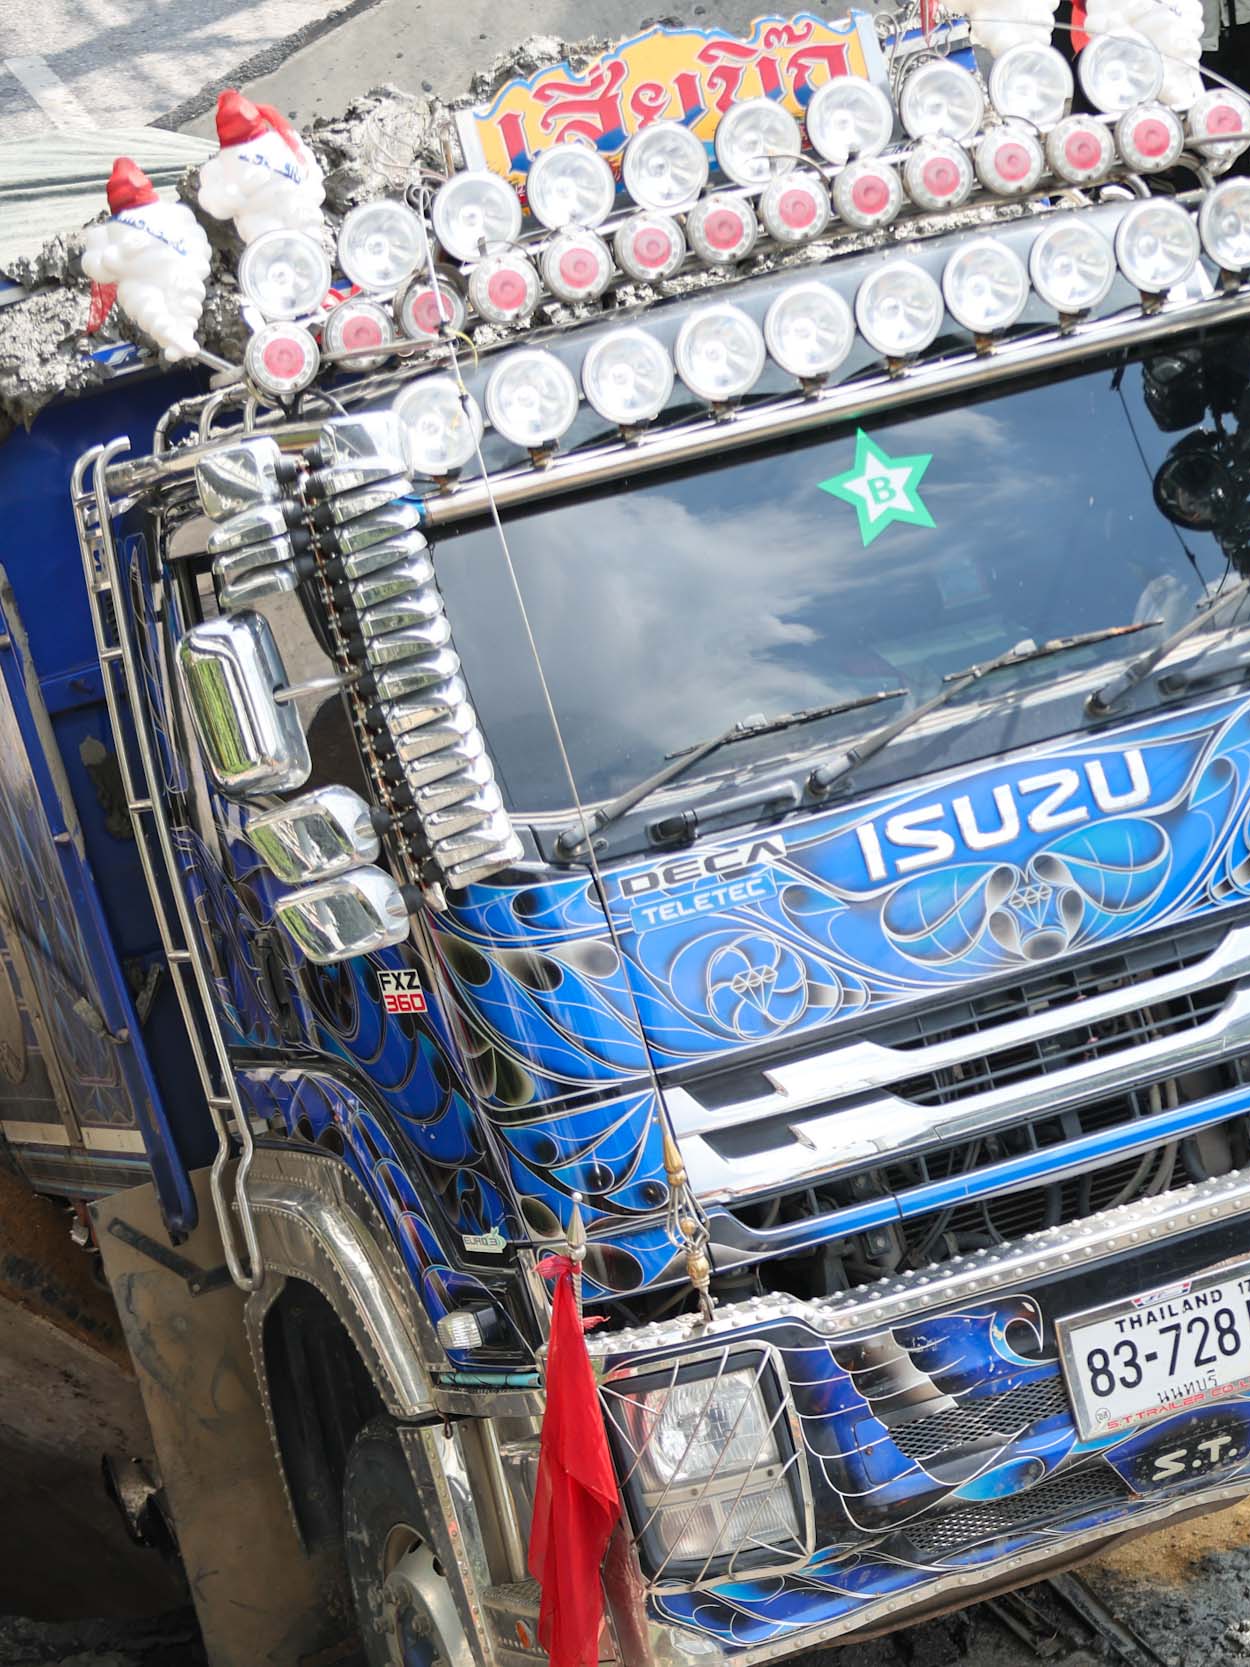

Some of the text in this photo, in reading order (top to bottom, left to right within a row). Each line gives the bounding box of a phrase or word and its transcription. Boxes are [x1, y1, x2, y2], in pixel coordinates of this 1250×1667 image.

[867, 476, 897, 504] B
[855, 749, 1152, 882] ISUZU
[619, 839, 786, 898] DECA
[641, 877, 767, 926] TELETEC
[379, 971, 421, 992] FXZ
[384, 993, 427, 1013] 360
[1115, 1288, 1224, 1334] THAILAND
[1151, 1435, 1238, 1481] S.T.
